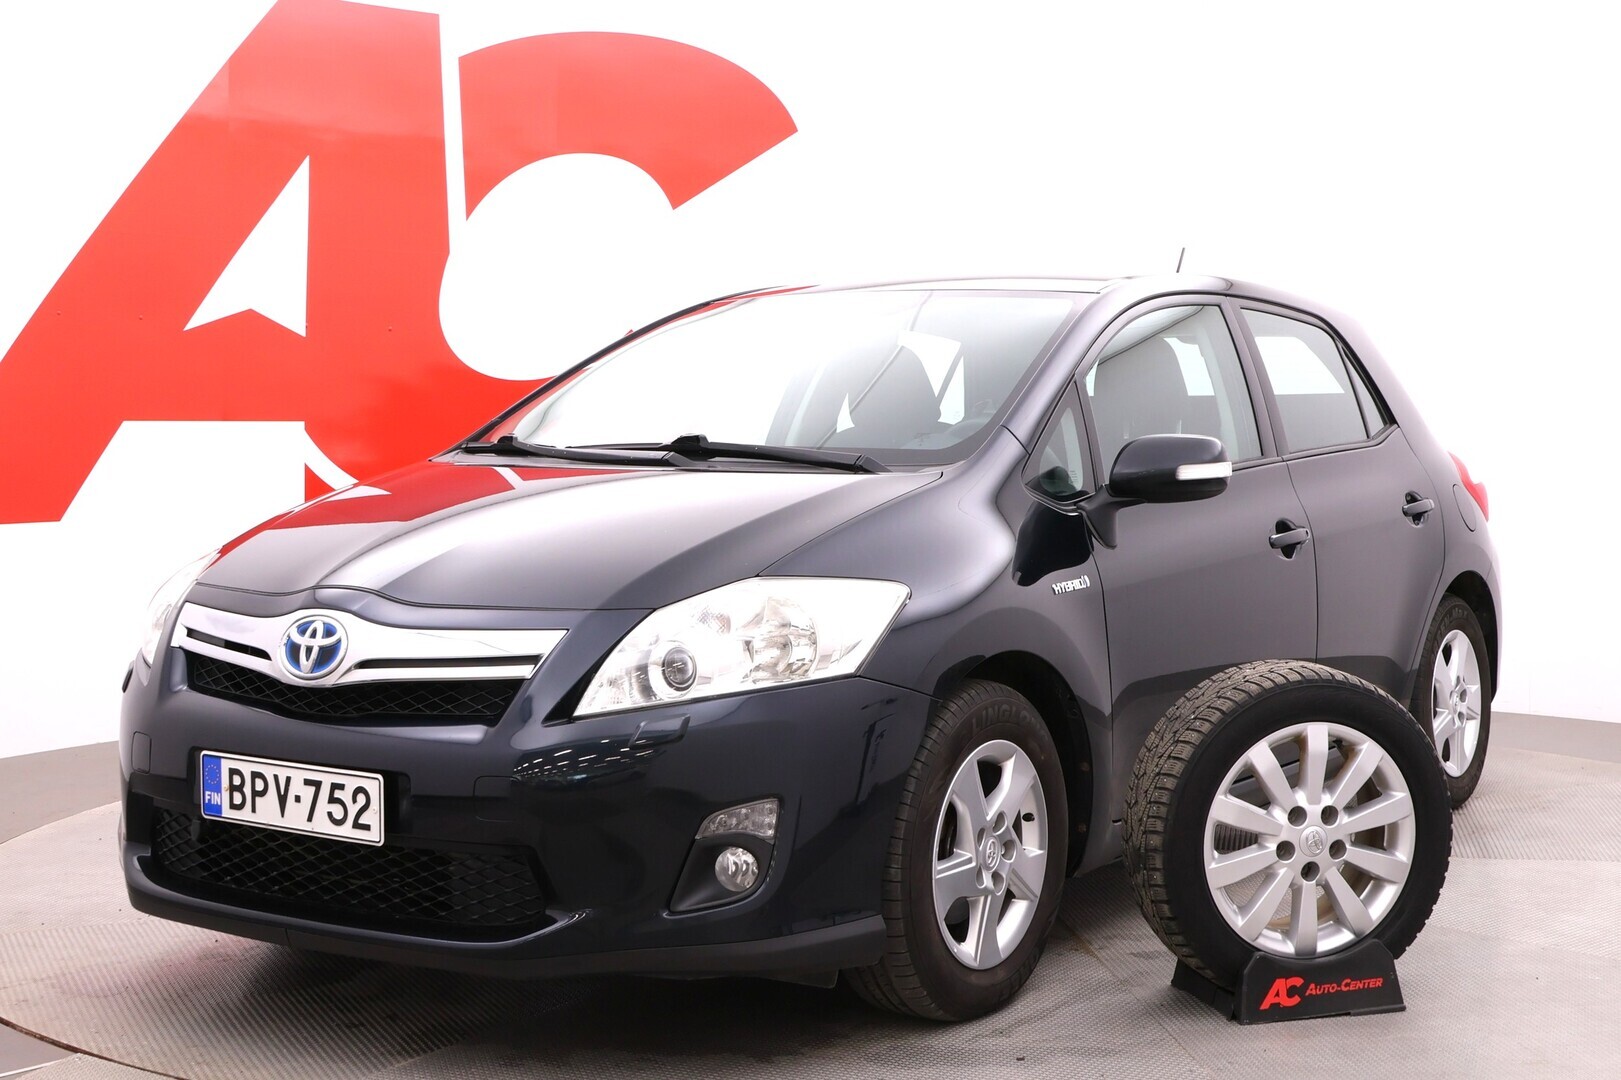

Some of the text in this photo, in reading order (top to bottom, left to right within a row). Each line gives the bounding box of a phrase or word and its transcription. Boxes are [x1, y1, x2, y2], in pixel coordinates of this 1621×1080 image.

[0, 0, 798, 524] AC
[1051, 578, 1084, 595] HYBRID
[205, 791, 222, 806] FIN
[228, 767, 372, 832] BPV-752
[1259, 976, 1305, 1010] AC
